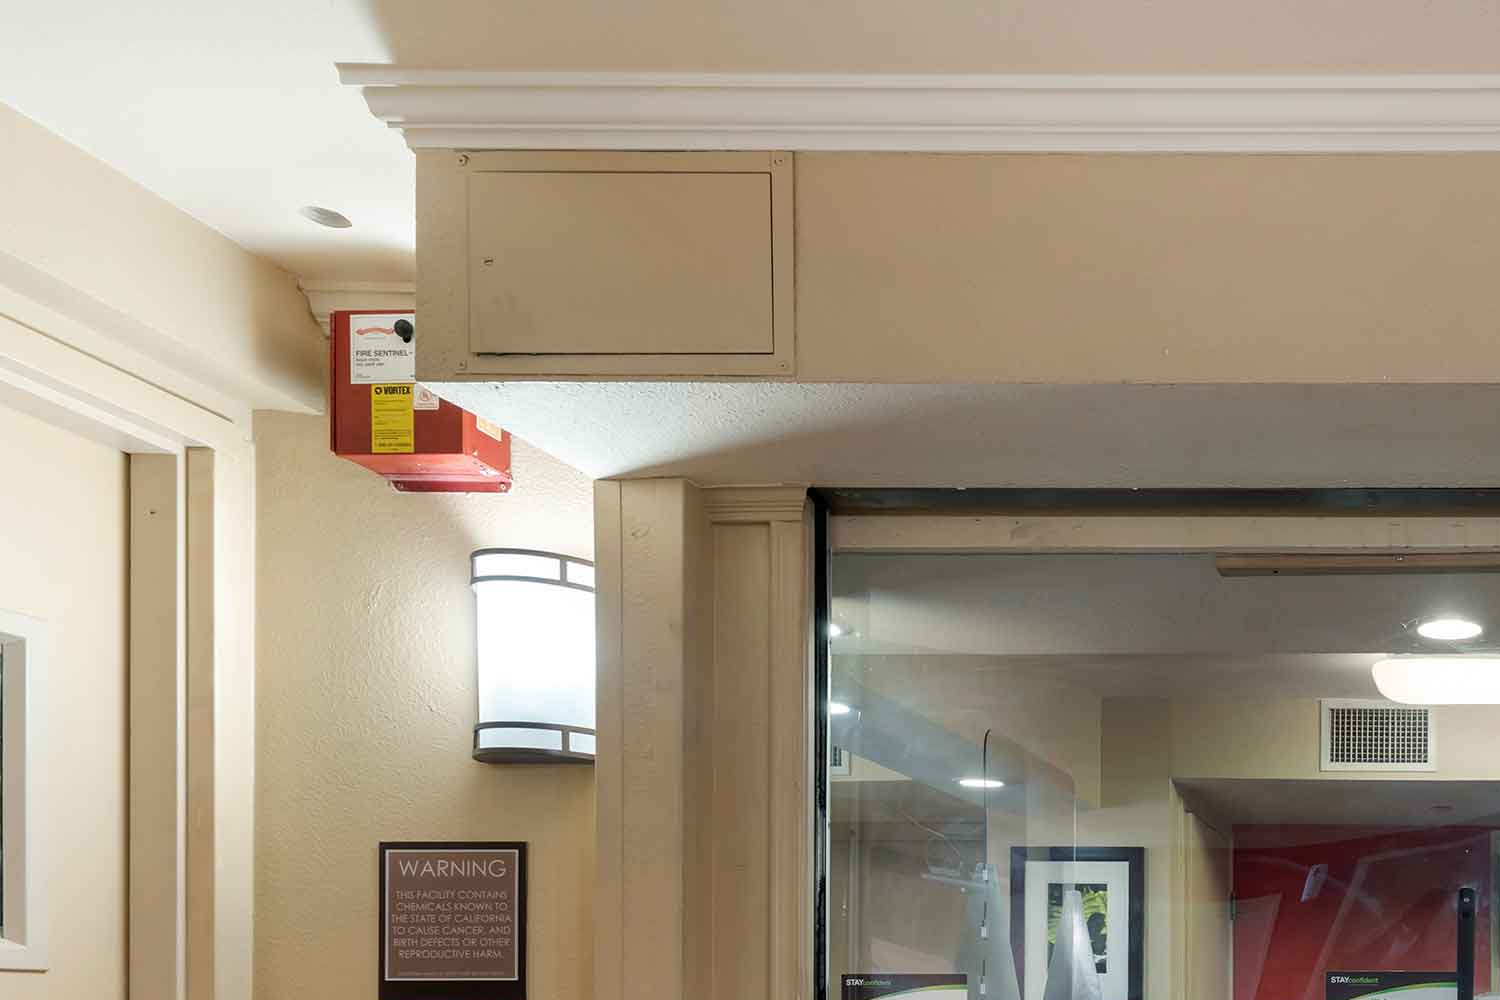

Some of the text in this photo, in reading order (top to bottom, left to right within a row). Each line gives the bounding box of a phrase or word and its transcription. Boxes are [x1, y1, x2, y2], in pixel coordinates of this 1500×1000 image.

[384, 386, 411, 395] VORTEX
[400, 860, 506, 878] WARNING
[396, 890, 508, 900] THIS FACILITY CONTAINS
[396, 902, 508, 912] CHEMICALS KNOWN TO
[392, 914, 512, 924] THE STATE OF CALIFORNIA
[393, 926, 406, 936] TO
[408, 926, 440, 936] CAUSE
[488, 926, 512, 936] AND
[394, 938, 512, 947] BIRTH DEFECTS OR OTHER
[400, 950, 471, 960] REPRODUCTIVE
